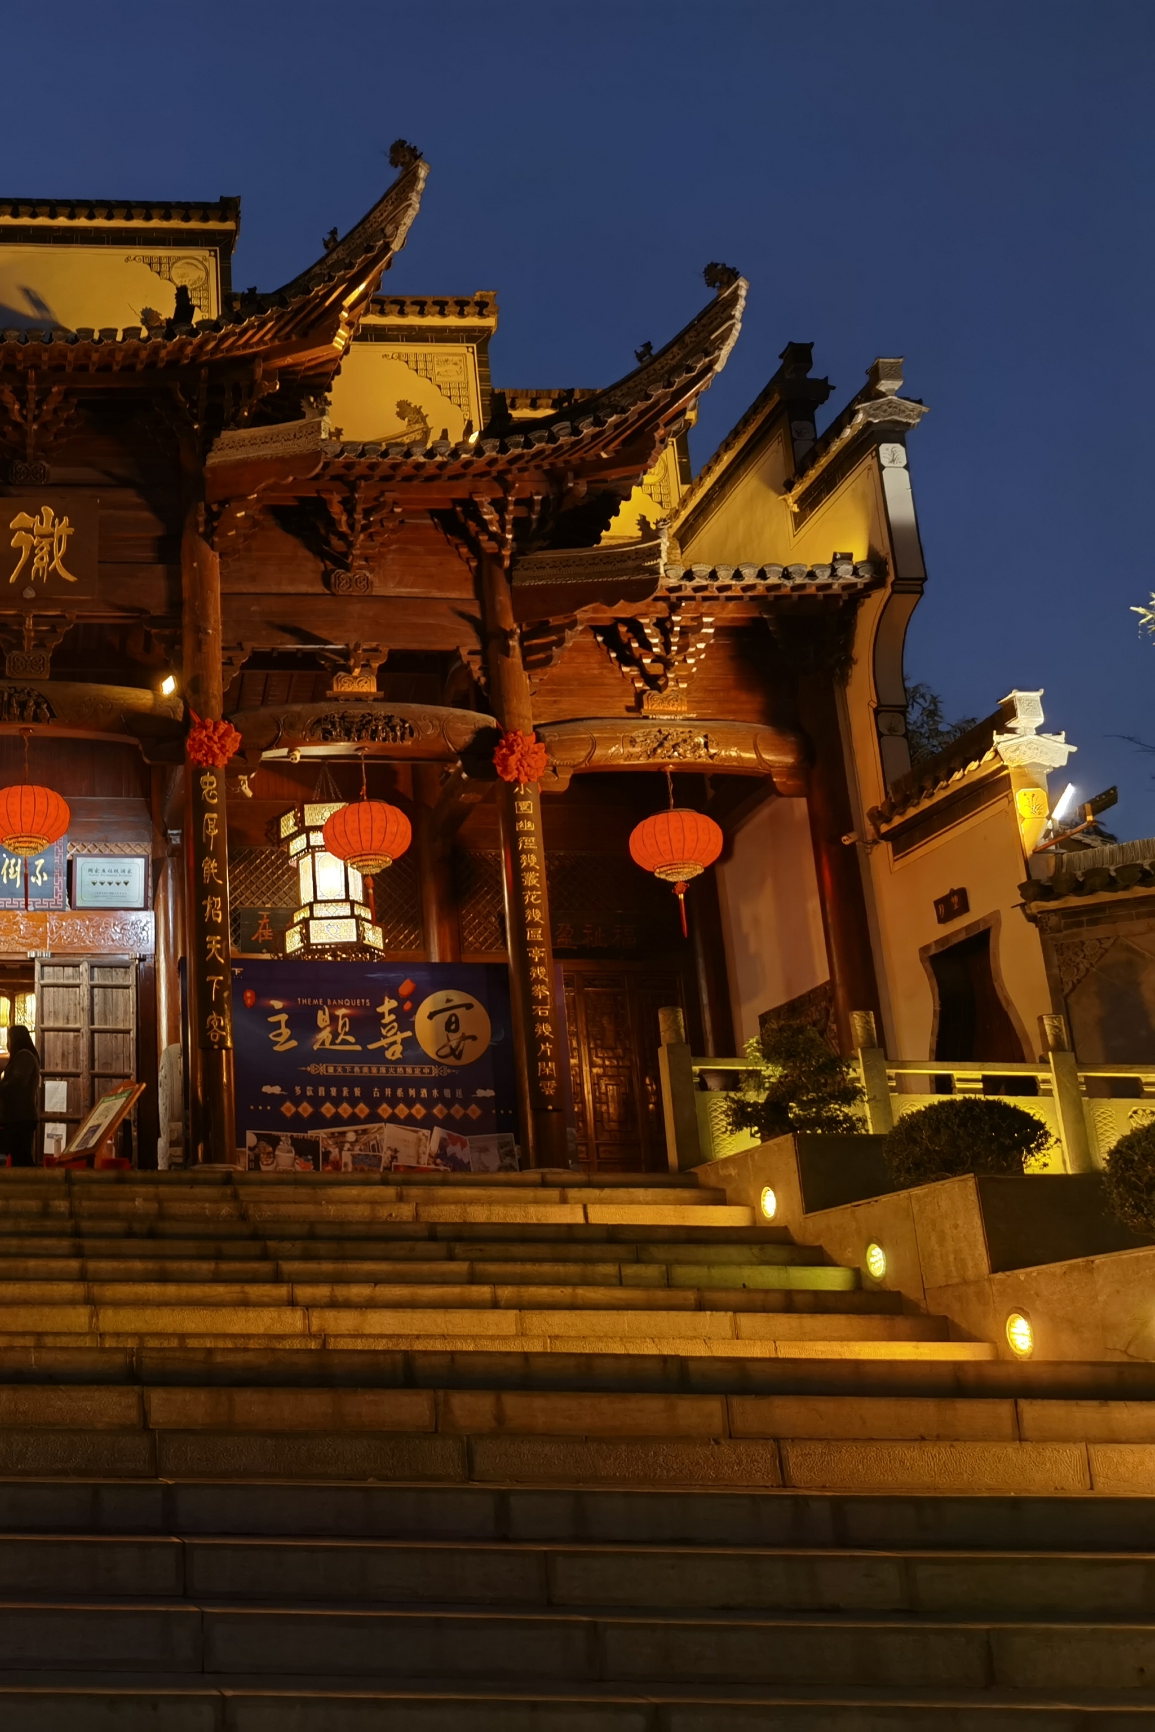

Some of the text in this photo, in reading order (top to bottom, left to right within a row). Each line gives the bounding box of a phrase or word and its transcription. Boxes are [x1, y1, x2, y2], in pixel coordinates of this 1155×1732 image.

[297, 997, 371, 1007] THEME BANQUETS
[267, 996, 478, 1061] 主题喜宴
